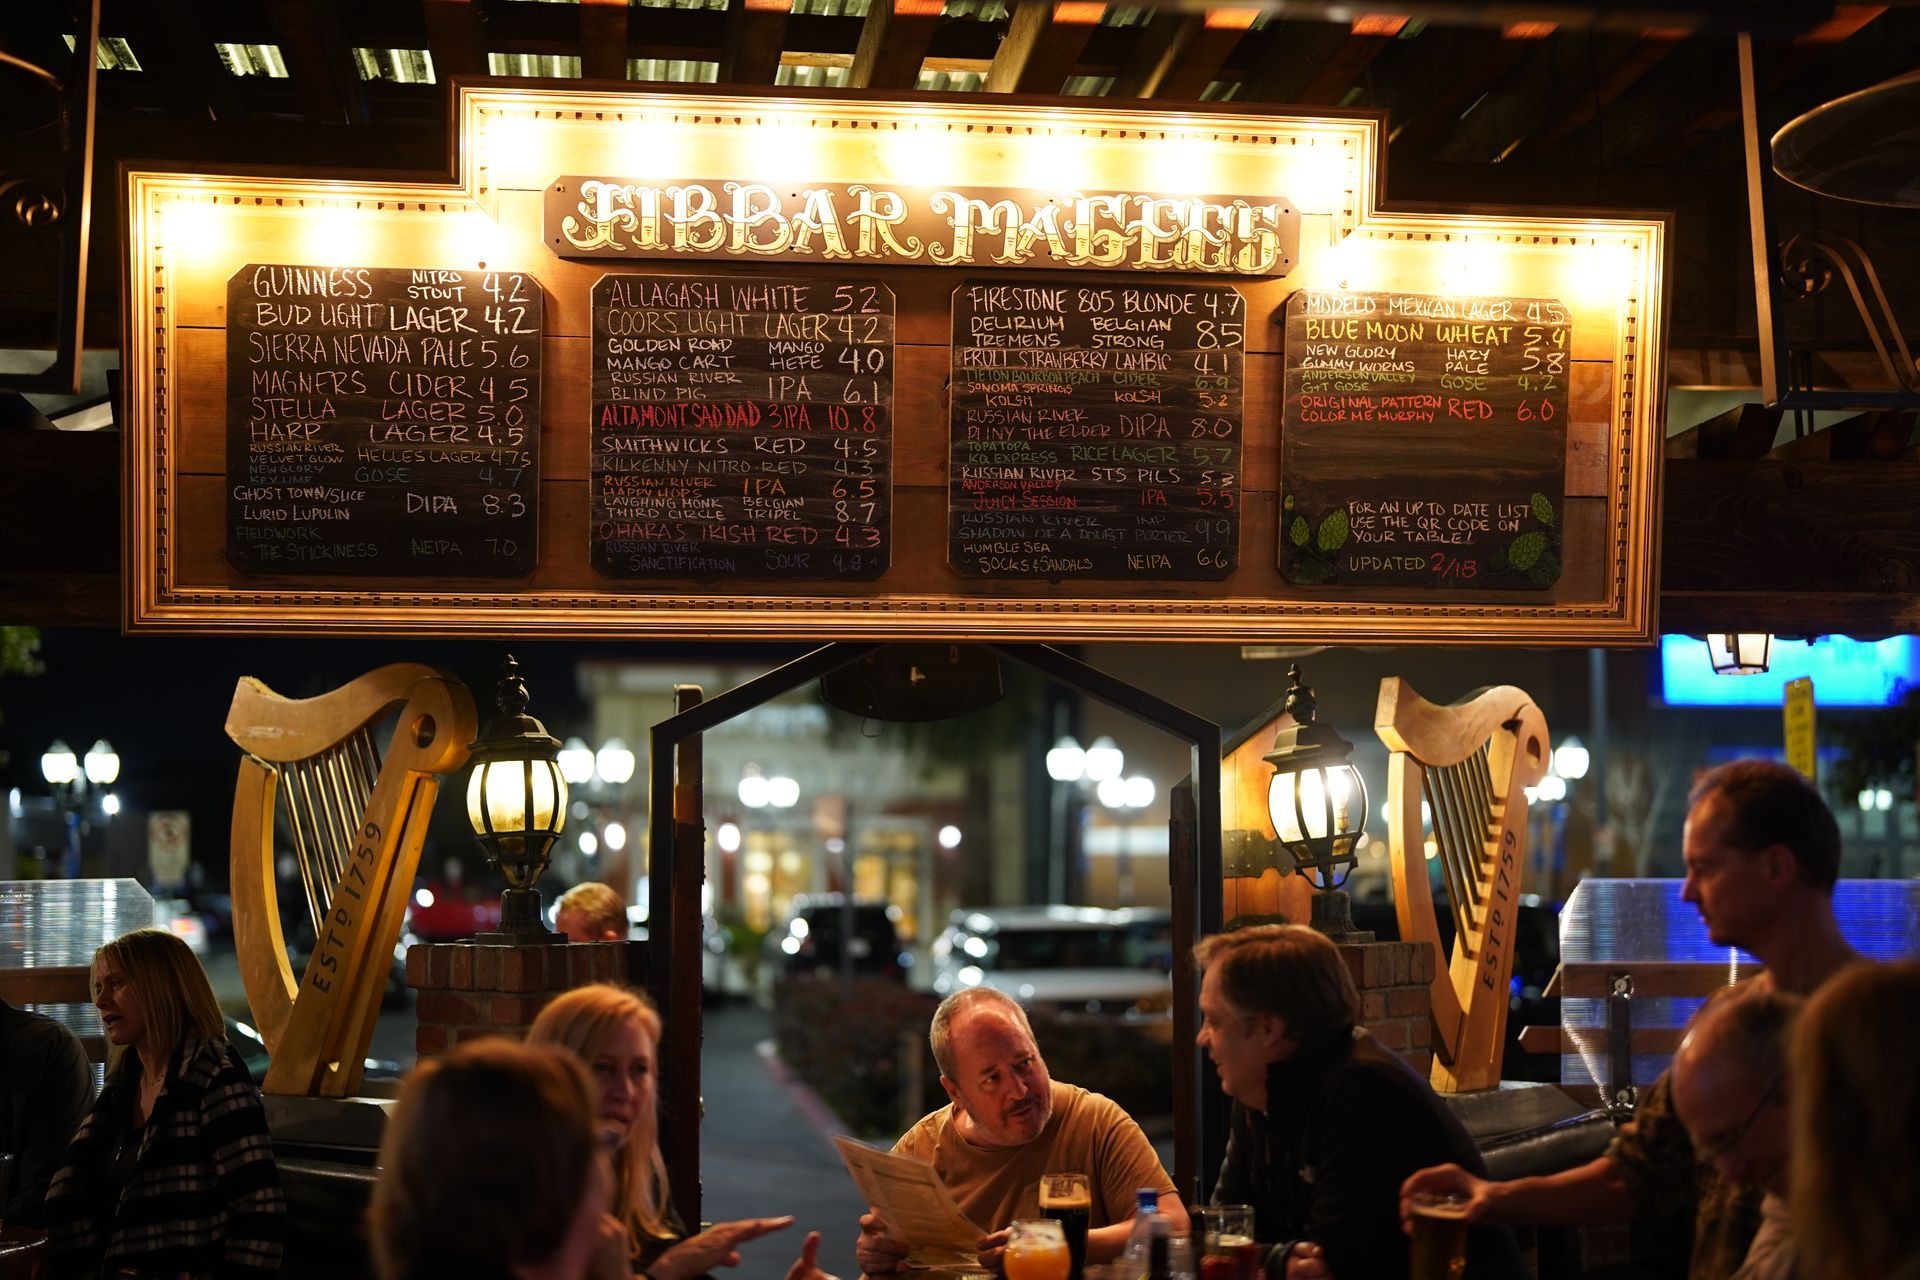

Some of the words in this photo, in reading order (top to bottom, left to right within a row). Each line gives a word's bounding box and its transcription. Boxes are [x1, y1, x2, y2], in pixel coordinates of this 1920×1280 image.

[562, 180, 923, 264] FIBBAR
[929, 189, 1281, 276] MAGEES
[254, 267, 373, 299] GUINNESS
[412, 270, 462, 284] NITRO
[408, 285, 465, 302] STOUT
[610, 280, 719, 309] ALLAGASH
[731, 282, 811, 312] WHITE
[971, 286, 1068, 313] FIRESTONE
[1078, 289, 1114, 313] 805
[1123, 290, 1196, 314] BLONDE
[1306, 297, 1376, 314] MODELO
[1389, 299, 1456, 318] MEXICAN
[1461, 301, 1517, 321] LAGER
[257, 304, 311, 326] BUD
[320, 304, 374, 328] LIGHT
[390, 305, 478, 333] LAGER
[608, 310, 677, 335] COORS
[688, 313, 750, 335] LIGHT
[765, 314, 831, 341] LAGER
[971, 317, 1064, 332] DELIRIUM
[1091, 317, 1172, 331] BELGIAN
[1306, 319, 1358, 339] BLUE
[1367, 322, 1424, 341] MOON
[1436, 324, 1513, 346] WHEAT
[608, 339, 680, 354] GOLDEN
[687, 340, 733, 352] ROAD
[769, 342, 824, 354] MANGO
[972, 333, 1061, 348] TREMENS
[1091, 335, 1164, 349] STRONG
[250, 332, 326, 363] SIERRA
[333, 335, 411, 363] NEVADA
[421, 339, 474, 368] PALE
[1306, 344, 1339, 355] NEW
[1345, 347, 1397, 359] GLORY
[1447, 349, 1490, 360] HAZY
[607, 357, 671, 370] MANGO
[679, 356, 735, 368] CART
[770, 356, 823, 371] HEFE
[1019, 351, 1108, 369] STRAWBERRY
[1302, 359, 1354, 370] GUMMY
[1360, 361, 1415, 373] WORMS
[1445, 363, 1489, 374] PALE
[252, 370, 367, 395] MAGNERS
[389, 371, 474, 398] CIDER
[612, 373, 677, 384] RUSSIAN
[689, 373, 742, 383] RIVER
[1302, 371, 1370, 381] ANDERSON
[1372, 374, 1416, 383] VALLEY
[1440, 374, 1487, 390] GOSE
[611, 387, 666, 400] BLIND
[676, 387, 706, 399] PIG
[769, 376, 811, 401] IPA
[1334, 383, 1369, 392] GOSE
[986, 394, 1033, 406] KOLSH
[1114, 391, 1161, 404] KOLSH
[251, 398, 336, 420] STELLA
[382, 400, 465, 420] LAGER
[693, 403, 723, 430] SAD
[725, 402, 761, 430] DAD
[967, 409, 1031, 424] RUSSIAN
[1037, 409, 1088, 423] RIVER
[1301, 397, 1377, 409] ORIGINAL
[1381, 397, 1442, 408] PATTERN
[1447, 400, 1492, 420] RED
[1301, 410, 1347, 422] COLOR
[1351, 411, 1372, 421] ME
[1378, 411, 1435, 423] MURPHY
[250, 422, 321, 441] HARP
[370, 424, 470, 444] LAGER
[1021, 428, 1052, 440] THE
[1059, 424, 1111, 438] ELDER
[1120, 415, 1171, 439] DIPA
[250, 443, 302, 453] RUSSIAN
[304, 444, 344, 453] RIVER
[602, 436, 728, 454] SMITHWICKS
[754, 437, 805, 454] RED
[250, 455, 302, 464] VELVET
[309, 455, 343, 464] GLOW
[358, 450, 425, 463] HELLES
[429, 452, 485, 464] LAGER
[1072, 446, 1108, 462] RICE
[1111, 448, 1178, 463] LAGER
[602, 457, 688, 473] KILKENNY
[698, 460, 750, 473] NITRO
[762, 460, 807, 473] RED
[355, 467, 411, 482] GOSE
[604, 476, 666, 487] RUSSIAN
[671, 477, 716, 488] RIVER
[962, 465, 1024, 480] RUSSIAN
[1030, 468, 1078, 481] RIVER
[1091, 467, 1126, 482] STS
[1137, 469, 1180, 484] PILS
[234, 486, 282, 501] GHOST
[744, 479, 787, 495] IPA
[407, 493, 458, 514] DIPA
[604, 498, 676, 508] LAUGHING
[683, 498, 723, 508] MONK
[743, 497, 804, 506] BELGIAN
[1022, 491, 1078, 508] SESSION
[1141, 488, 1168, 506] IPA
[244, 505, 287, 520] LURID
[294, 505, 351, 520] LUPULIN
[606, 508, 659, 519] THIRD
[668, 509, 726, 520] CIRCLE
[1350, 501, 1377, 515] FOR
[1380, 502, 1399, 515] AN
[1405, 503, 1423, 515] UP
[1427, 504, 1445, 515] TO
[1453, 504, 1490, 517] DATE
[1499, 505, 1530, 518] LIST
[1350, 517, 1375, 529] USE
[1382, 517, 1408, 528] THE
[1448, 518, 1490, 531] CODE
[1499, 520, 1519, 531] ON
[767, 526, 818, 545] RED
[1353, 530, 1395, 543] YOUR
[1404, 531, 1472, 544] TABLE!
[963, 542, 1019, 553] HUMBLE
[1024, 543, 1051, 553] SEA
[1128, 554, 1171, 570] NEIPA
[1350, 556, 1425, 570] UPDATED
[345, 822, 381, 900] 1759
[1497, 830, 1516, 900] 1759
